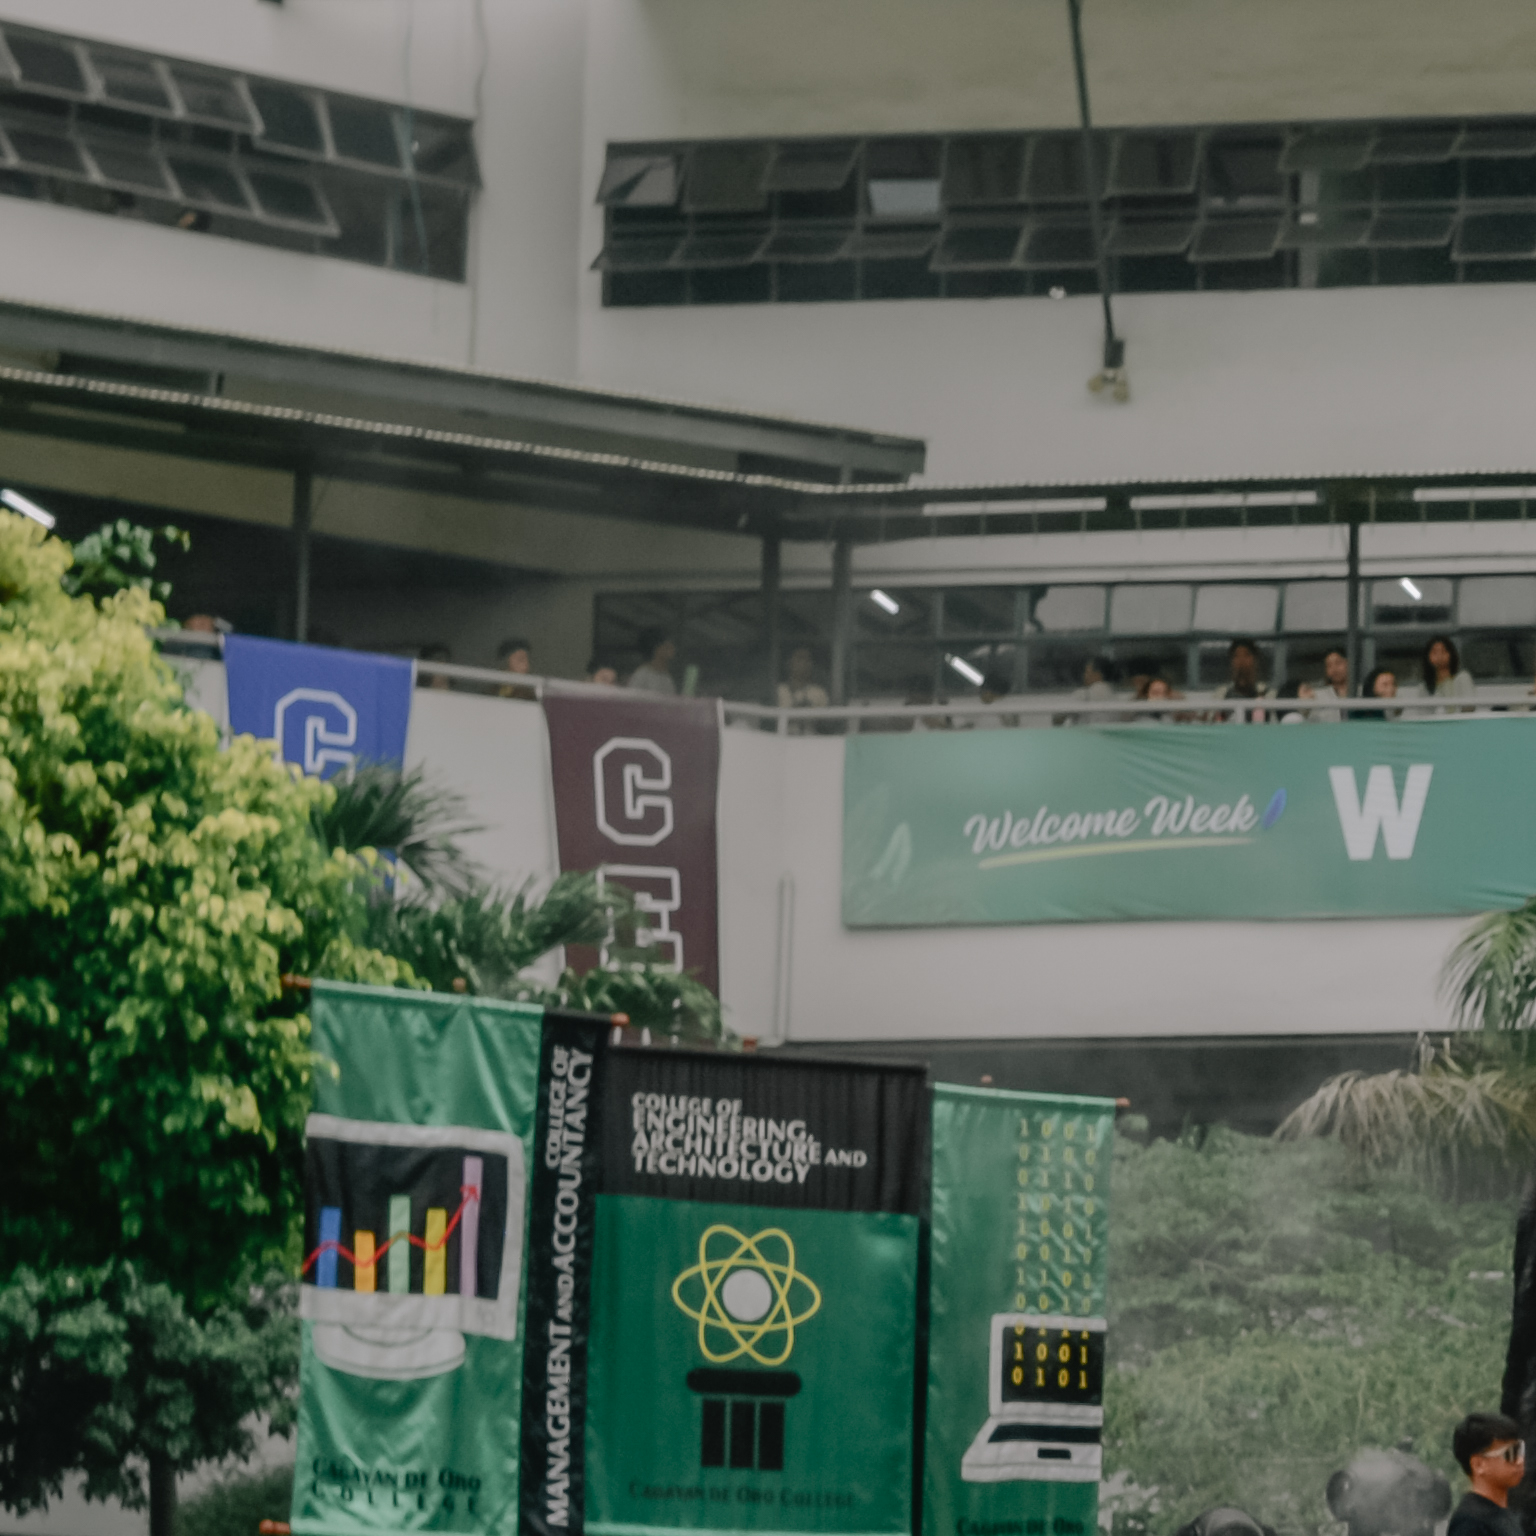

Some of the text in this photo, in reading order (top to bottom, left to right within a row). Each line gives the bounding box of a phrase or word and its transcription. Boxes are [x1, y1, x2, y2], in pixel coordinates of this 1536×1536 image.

[962, 793, 1259, 855] Welcome Week
[545, 1044, 570, 1170] COLLEGE OF
[632, 1092, 743, 1116] COLLEGE OF
[633, 1108, 815, 1144] ENGINEERING,
[632, 1130, 868, 1168] ARCHITECTURE AND
[634, 1150, 811, 1184] TECHNOLOGY
[545, 1047, 594, 1528] MANAGEMENT AND ACCOUNTANCY
